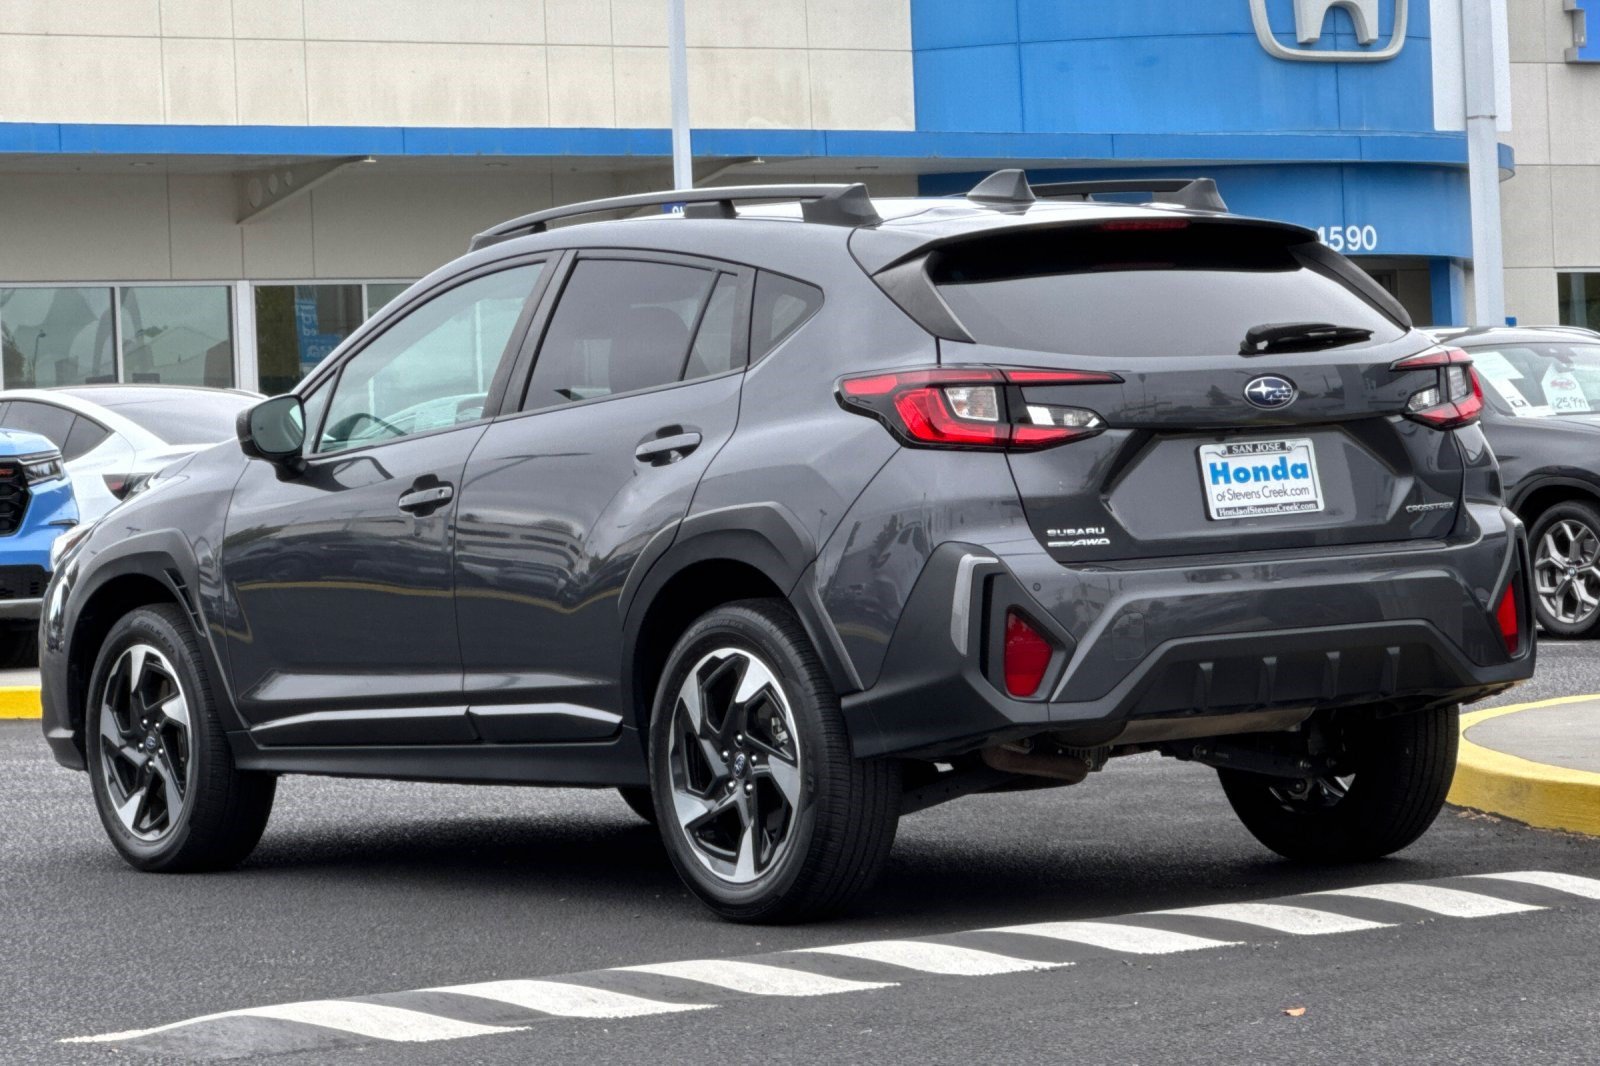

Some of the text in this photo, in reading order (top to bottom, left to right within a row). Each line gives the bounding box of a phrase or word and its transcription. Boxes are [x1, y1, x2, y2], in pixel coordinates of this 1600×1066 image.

[1232, 442, 1281, 454] SAN JOSE
[1208, 456, 1309, 485] Honda
[1216, 483, 1310, 502] of Stevens Creek.com
[1046, 527, 1105, 537] SUBARU
[1072, 537, 1111, 547] AWD
